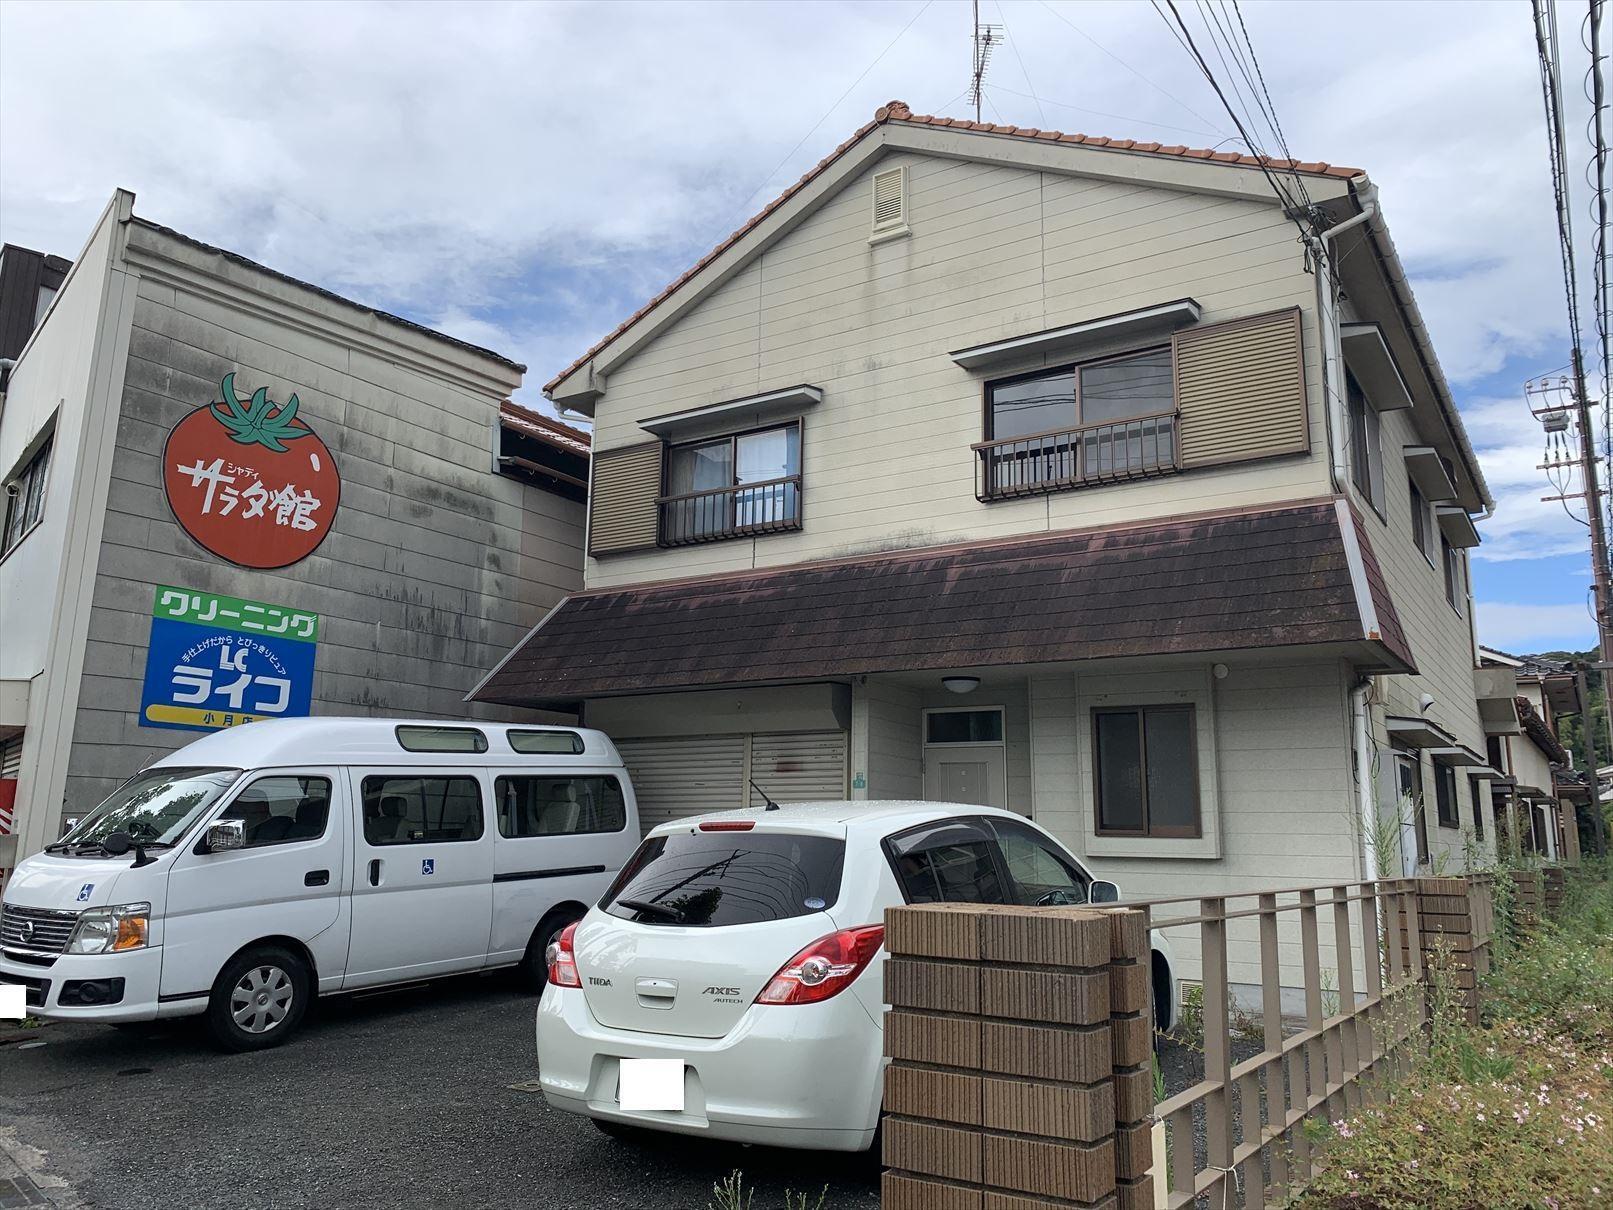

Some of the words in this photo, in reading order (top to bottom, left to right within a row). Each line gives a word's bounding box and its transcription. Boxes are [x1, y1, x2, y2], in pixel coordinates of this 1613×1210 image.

[227, 462, 260, 480] シャディ
[176, 458, 321, 532] サラダ館
[160, 590, 317, 638] クリーニング
[181, 635, 233, 663] 手仕上げだから
[237, 636, 287, 676] とびっきりピュア
[219, 645, 249, 672] LC
[171, 664, 291, 713] ライコ
[588, 977, 613, 988] TIIDA
[702, 986, 741, 996] AXIS
